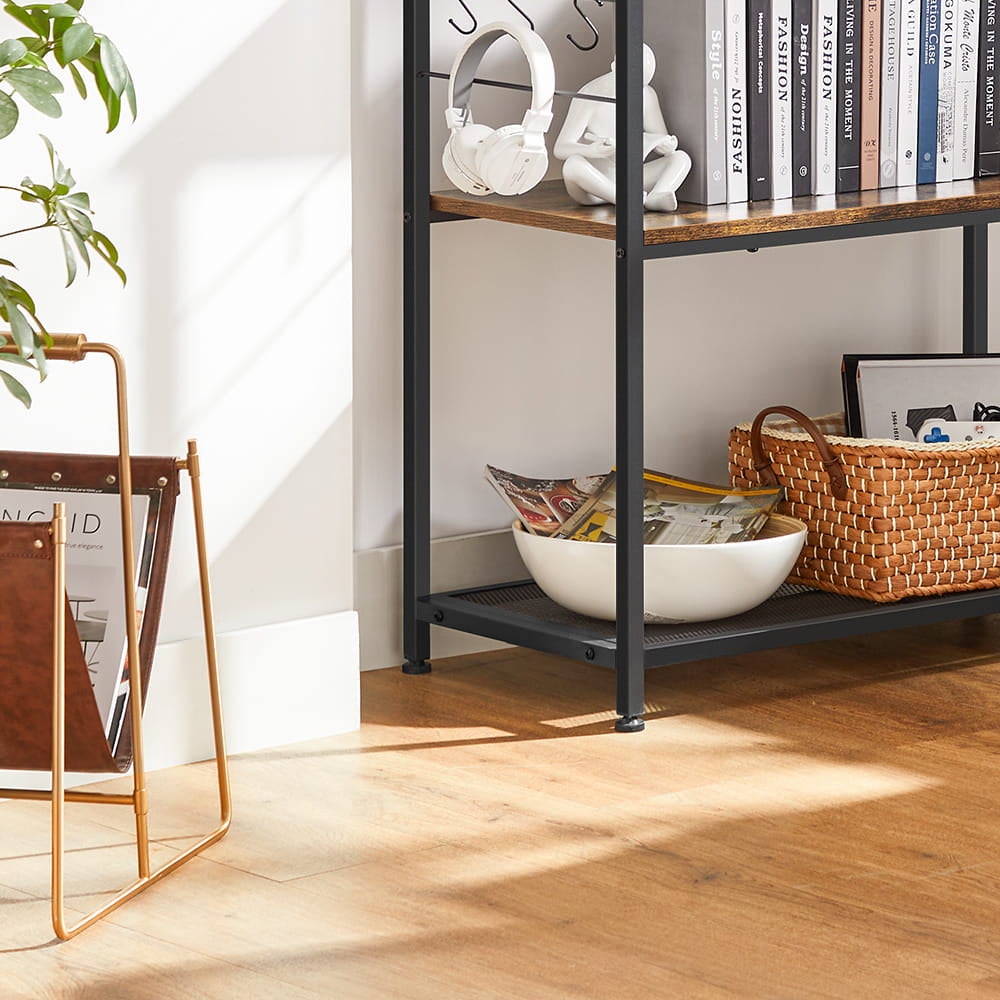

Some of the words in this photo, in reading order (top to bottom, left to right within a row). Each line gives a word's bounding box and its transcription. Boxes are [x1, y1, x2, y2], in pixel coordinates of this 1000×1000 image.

[906, 10, 915, 57] GUILD
[962, 9, 975, 40] Monte
[986, 30, 995, 43] IN
[709, 30, 722, 80] Style
[778, 16, 788, 102] FASHION
[799, 23, 809, 75] Design
[822, 15, 832, 101] FASHION
[845, 43, 854, 55] IN
[845, 59, 854, 84] THE
[887, 37, 896, 80] HOUSE
[928, 33, 939, 65] Case
[960, 43, 974, 72] Cristo
[986, 47, 995, 71] THE
[844, 89, 853, 141] MOMENT
[985, 76, 995, 127] MOMENT
[731, 88, 743, 174] FASHION
